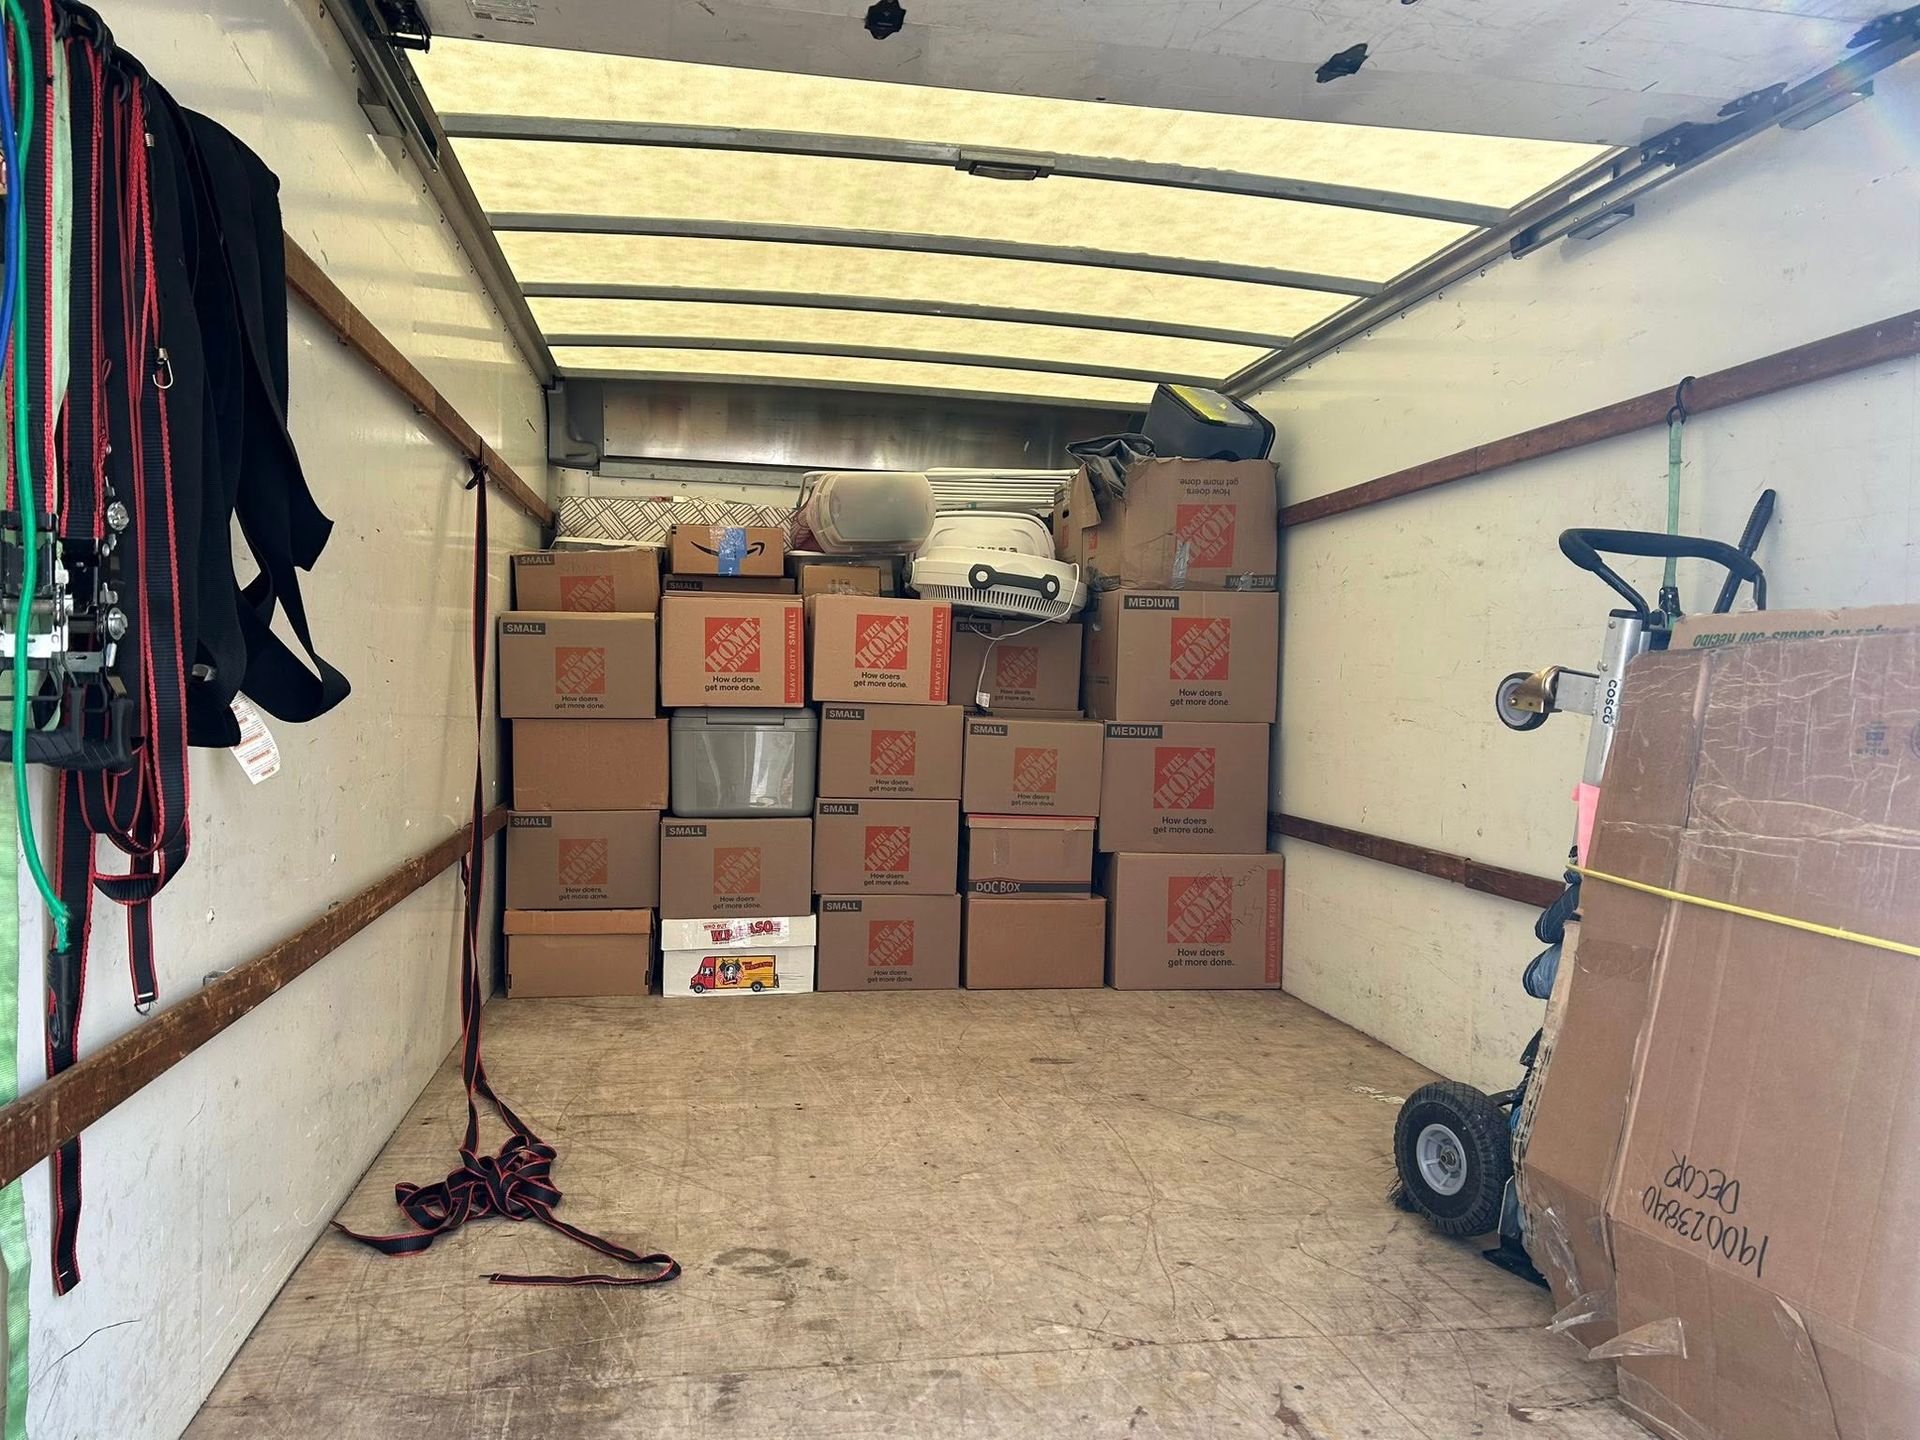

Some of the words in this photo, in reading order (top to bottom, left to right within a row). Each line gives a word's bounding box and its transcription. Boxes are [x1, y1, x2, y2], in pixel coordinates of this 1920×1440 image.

[1188, 505, 1235, 564] HOM
[1205, 537, 1228, 560] THE
[1129, 598, 1175, 607] MEDIUM
[507, 624, 542, 632] SMALL
[711, 623, 734, 645] THE
[855, 615, 909, 669] HOME
[862, 620, 883, 642] THE
[935, 612, 944, 644] SMALL
[1177, 624, 1202, 649] THE
[705, 618, 760, 672] HOME
[727, 637, 760, 672] DEPOT
[876, 634, 908, 669] DEPOT
[1170, 618, 1230, 680] HOME
[556, 648, 605, 694] HOME
[562, 652, 582, 671] THE
[1194, 640, 1230, 680] DEPOT
[575, 664, 604, 694] DEPOT
[830, 710, 861, 718] SMALL
[1170, 698, 1184, 706] get
[1602, 680, 1618, 724] COSCO
[876, 735, 894, 753] THE
[973, 726, 1004, 734] SMALL
[1111, 727, 1158, 736] MEDIUM
[871, 730, 915, 776] HOME
[888, 747, 915, 776] DEPOT
[1018, 752, 1036, 771] THE
[1161, 753, 1186, 779] THE
[1013, 748, 1058, 793] HOME
[1031, 764, 1058, 793] DEPOT
[1154, 747, 1216, 809] HOME
[1178, 769, 1215, 809] DEPOT
[824, 805, 854, 813] SMALL
[1184, 816, 1208, 825] doers
[870, 831, 889, 849] THE
[1153, 826, 1167, 834] get
[865, 826, 911, 871] HOME
[883, 842, 910, 871] DEPOT
[976, 882, 999, 893] DOC
[1000, 882, 1020, 893] BOX
[1175, 884, 1201, 911] THE
[827, 902, 858, 910] SMALL
[1167, 877, 1233, 943] HOME
[874, 925, 892, 944] THE
[1193, 901, 1232, 943] DEPOT
[869, 921, 914, 966] HOME
[887, 937, 913, 966] DEPOT
[1168, 958, 1183, 967] get
[1664, 1150, 1740, 1214] DECOR
[1642, 1186, 1769, 1278] 190023840
